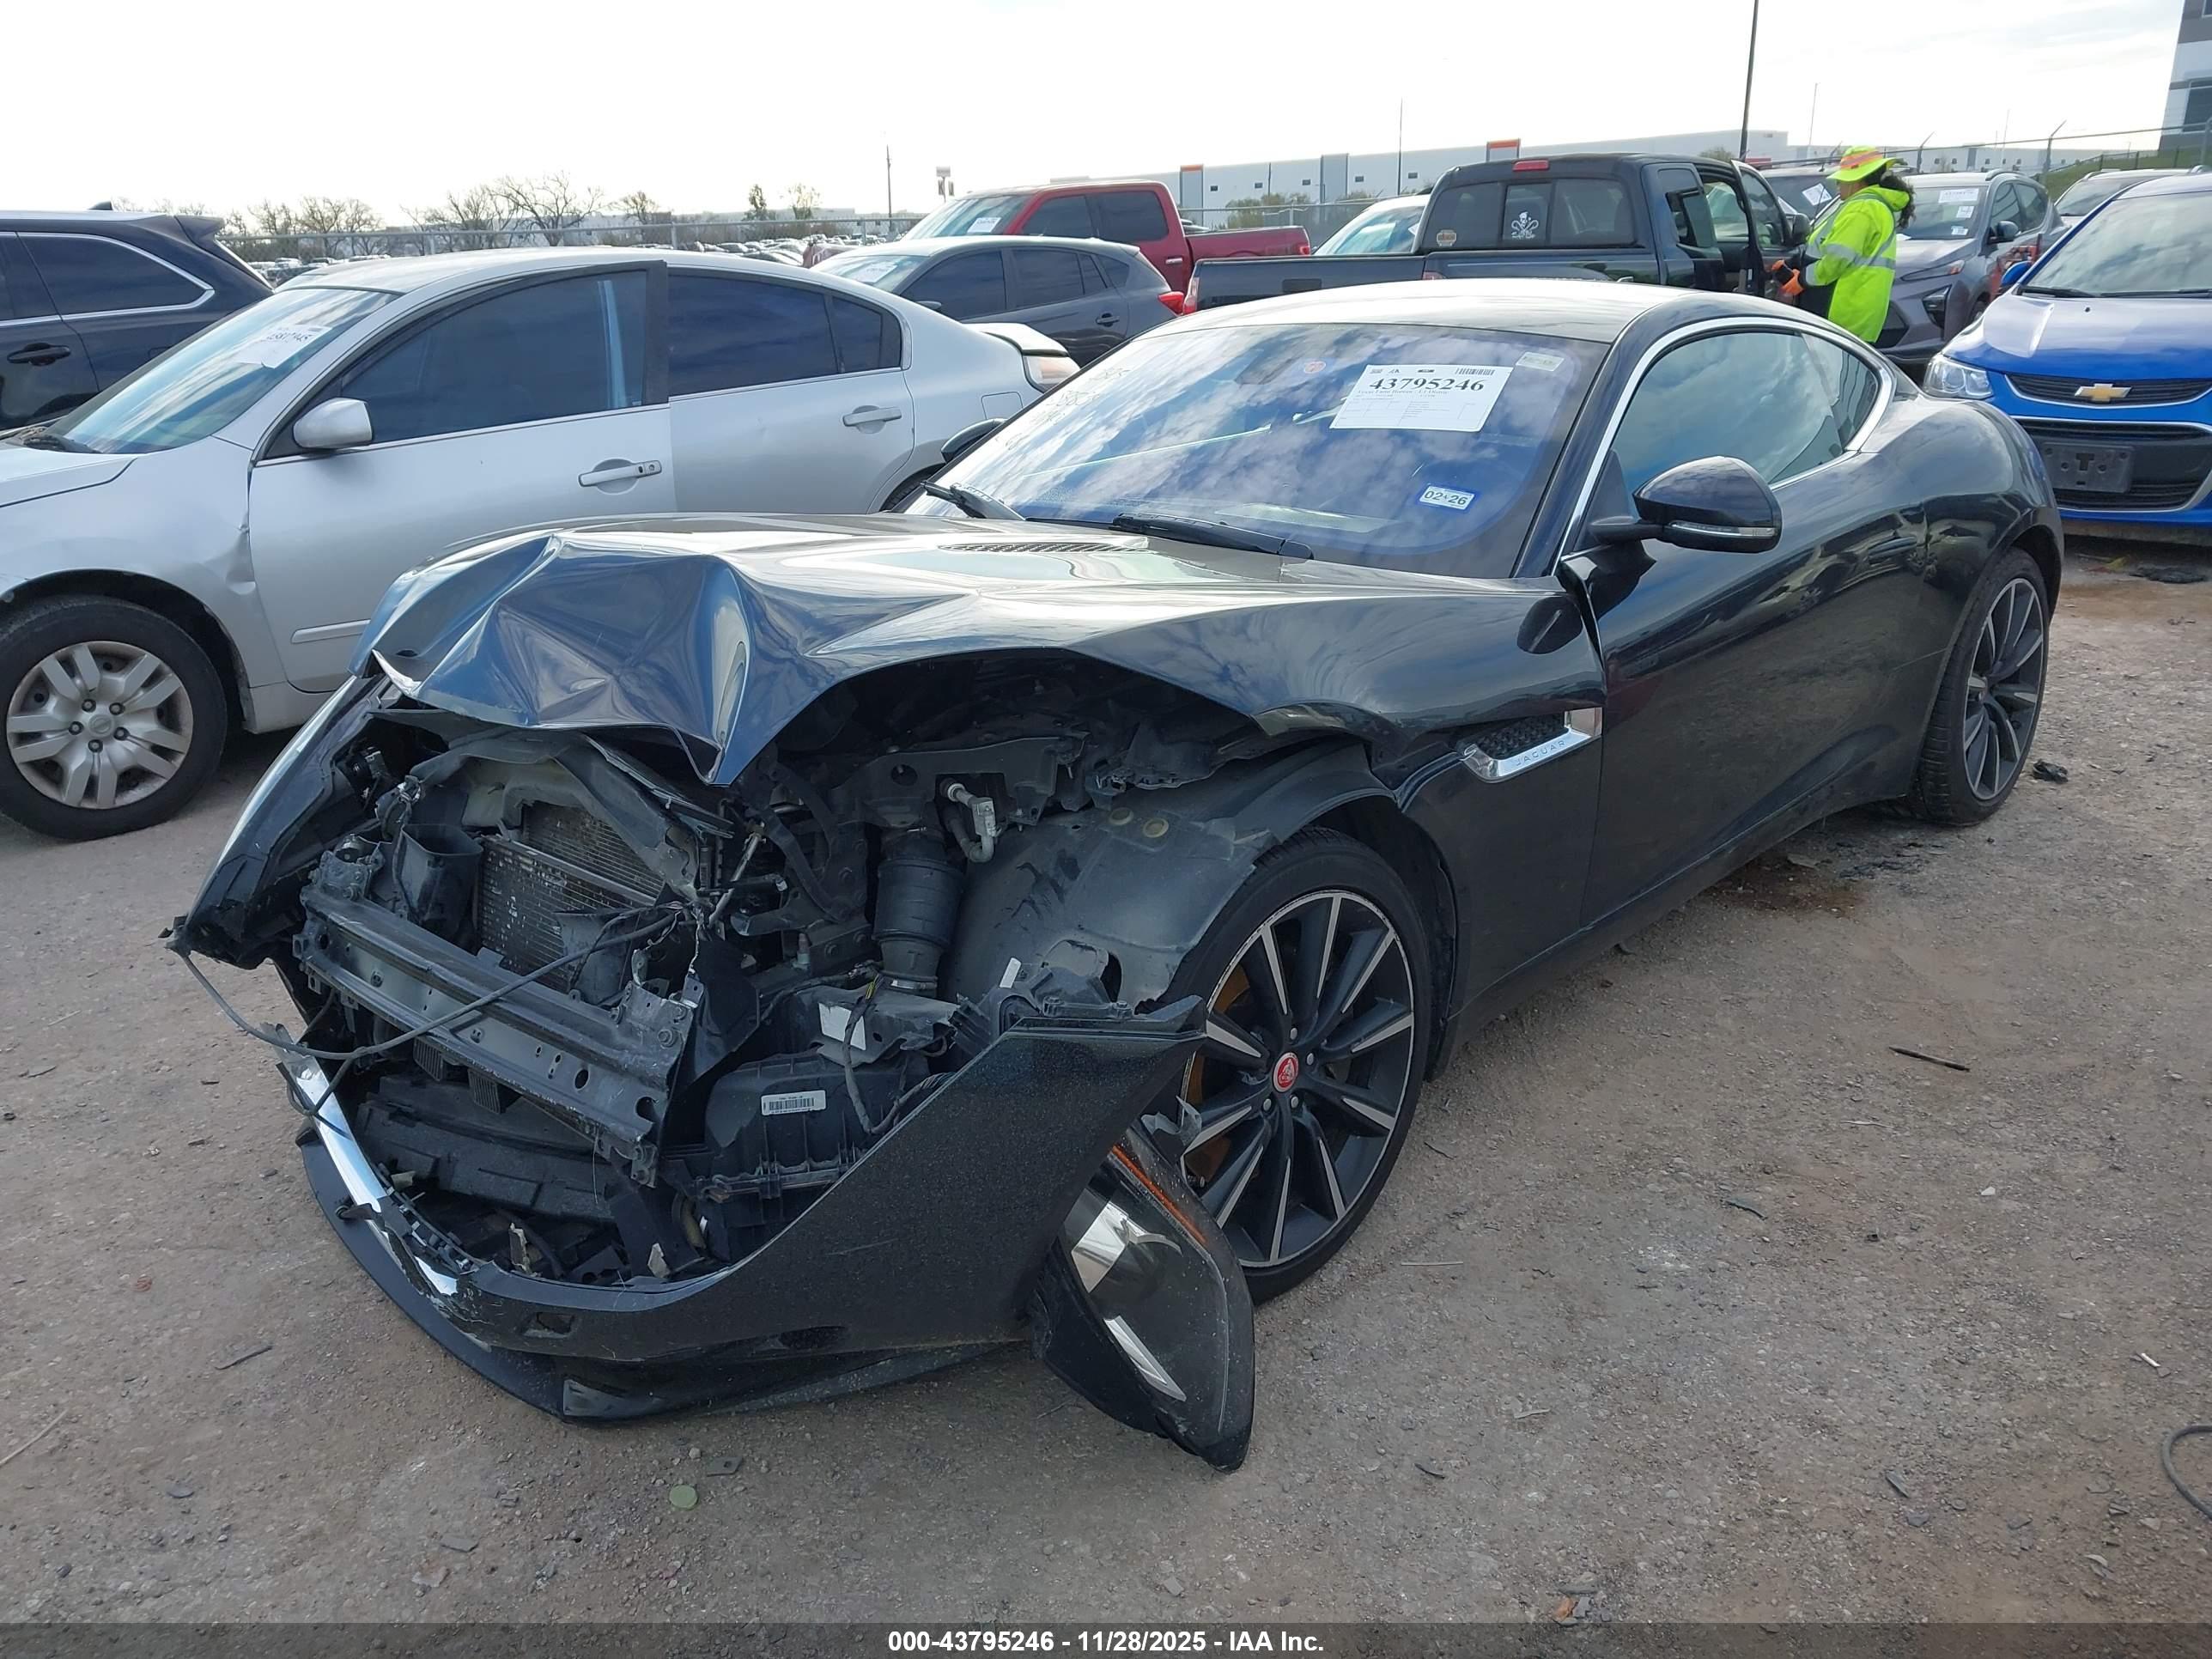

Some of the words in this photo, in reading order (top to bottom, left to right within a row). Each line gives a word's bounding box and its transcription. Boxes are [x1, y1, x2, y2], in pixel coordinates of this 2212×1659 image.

[1370, 377, 1486, 392] 43795246
[1424, 490, 1443, 501] 02
[1448, 495, 1468, 505] 26
[1516, 740, 1565, 767] JAGUAR
